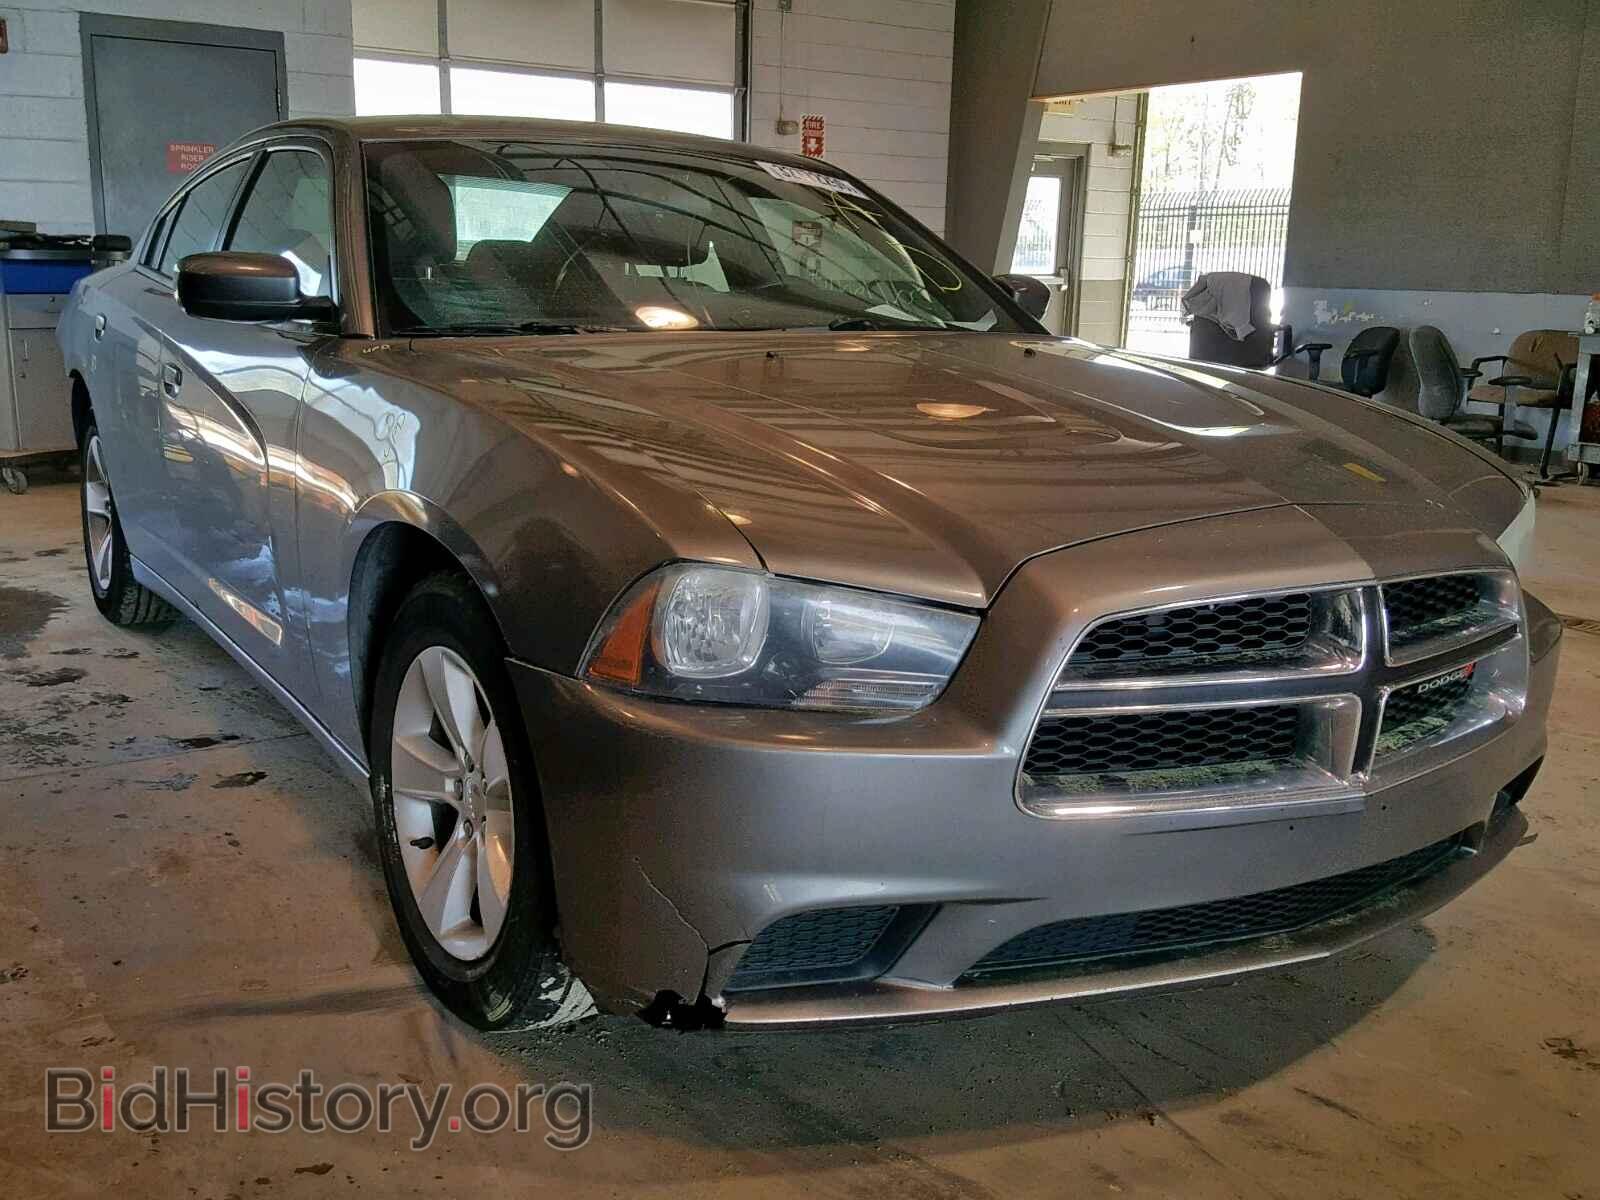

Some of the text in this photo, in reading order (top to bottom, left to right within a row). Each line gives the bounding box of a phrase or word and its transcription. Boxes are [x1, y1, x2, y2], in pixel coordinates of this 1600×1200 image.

[169, 144, 215, 153] SPRINKLER
[181, 153, 204, 162] RISER
[181, 163, 200, 171] ROO
